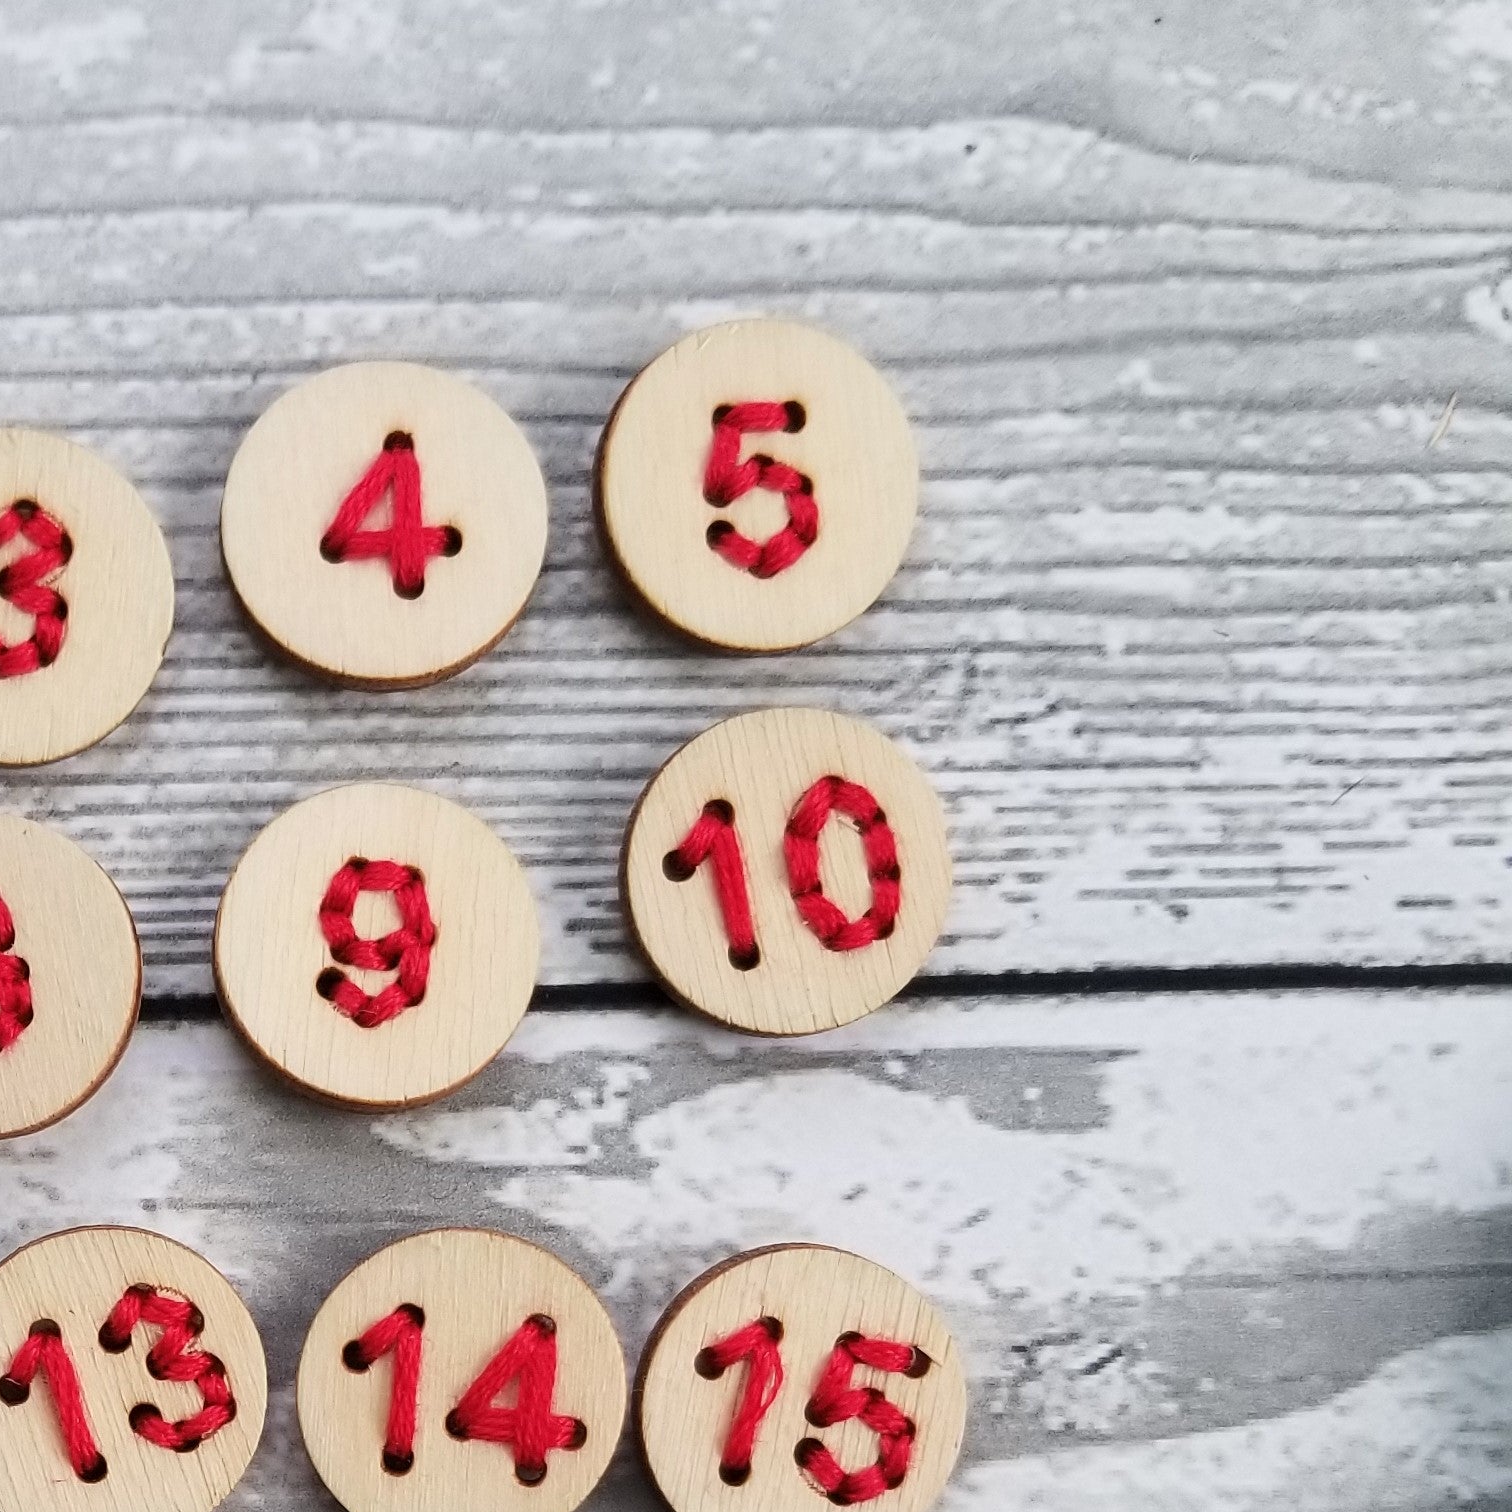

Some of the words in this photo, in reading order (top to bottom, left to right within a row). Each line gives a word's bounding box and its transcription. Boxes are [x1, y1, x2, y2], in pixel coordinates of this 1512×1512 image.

[321, 431, 462, 599] 4
[703, 401, 820, 579] 5
[316, 859, 437, 1028] 9
[663, 774, 902, 971] 10
[343, 1304, 587, 1486] 14
[697, 1317, 932, 1506] 15
